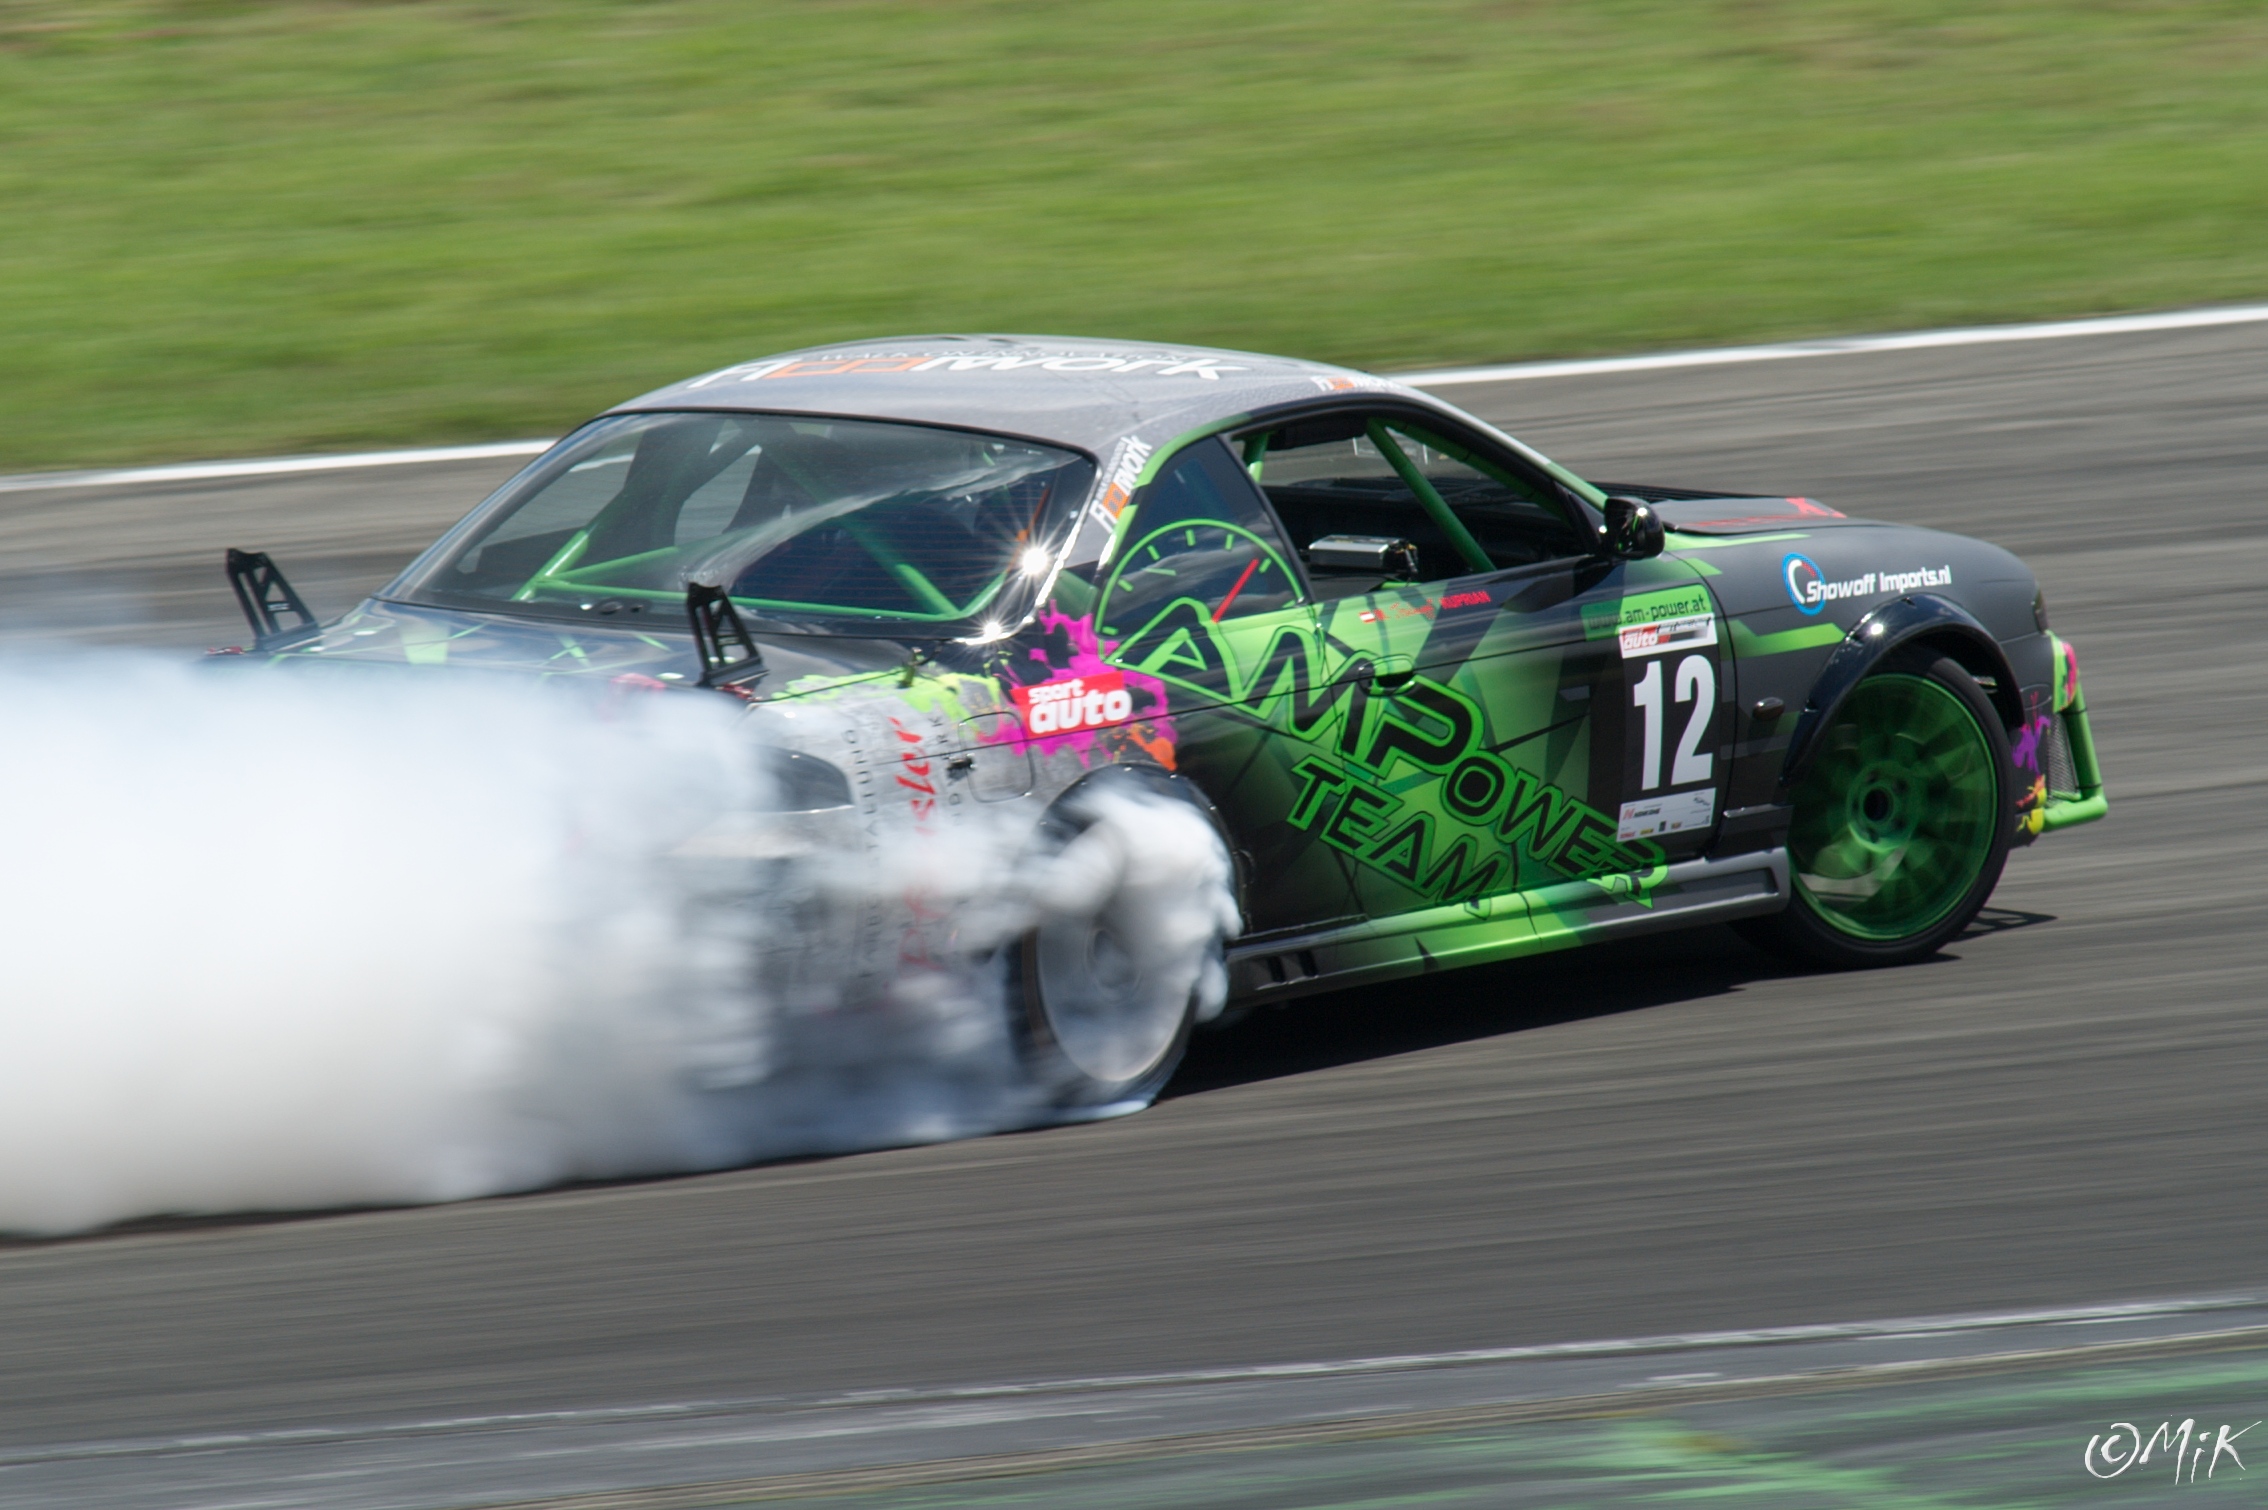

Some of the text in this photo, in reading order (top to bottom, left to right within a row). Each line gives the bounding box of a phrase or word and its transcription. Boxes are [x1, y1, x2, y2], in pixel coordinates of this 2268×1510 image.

[1806, 565, 1952, 603] Showoff Imports.nl
[1028, 679, 1085, 705] sport
[1029, 689, 1132, 734] auto
[1633, 654, 1714, 791] 12
[1287, 755, 1509, 920] TEAM
